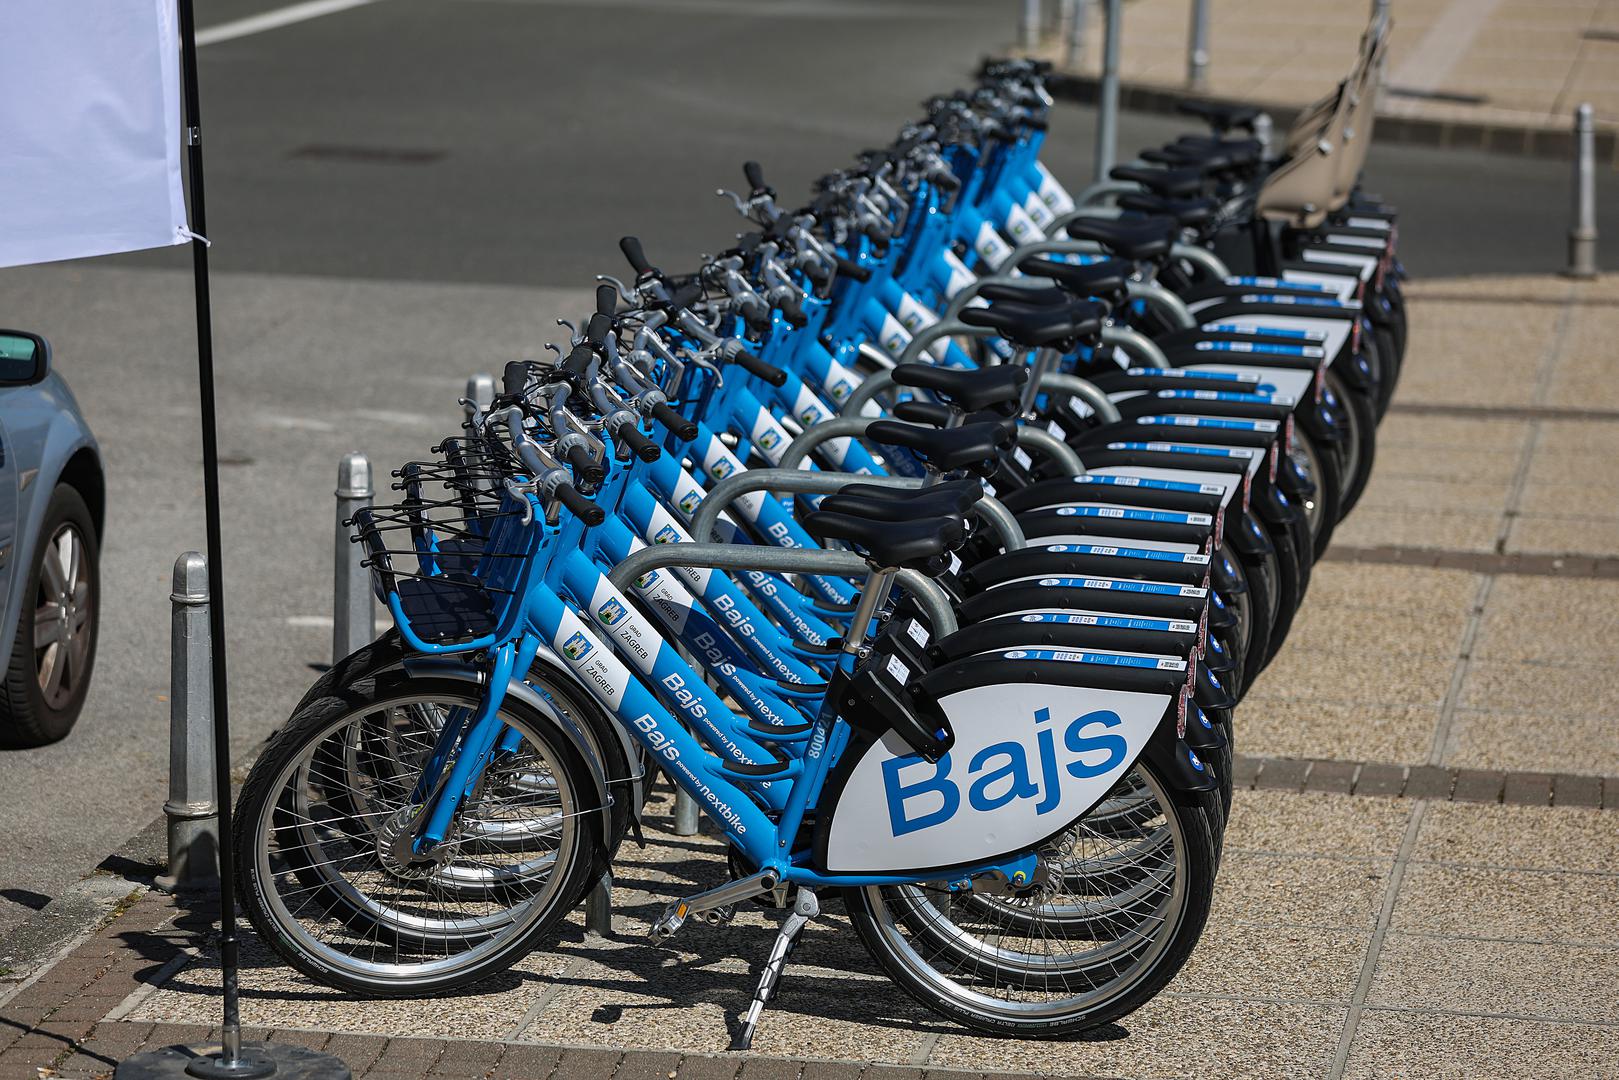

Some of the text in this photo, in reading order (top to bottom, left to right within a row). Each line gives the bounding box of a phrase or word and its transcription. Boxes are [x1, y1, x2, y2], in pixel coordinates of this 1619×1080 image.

[660, 588, 674, 601] GRAD
[747, 570, 777, 597] ajs
[652, 593, 680, 622] ZAGREB
[629, 624, 642, 638] GRAD
[713, 593, 755, 637] Bajs
[751, 636, 770, 655] powered
[768, 652, 775, 660] by
[620, 630, 649, 660] ZAGREB
[585, 665, 616, 696] ZAGREB
[594, 659, 608, 674] GRAD
[693, 631, 737, 676] Bajs
[732, 675, 751, 695] powered
[749, 692, 757, 701] by
[662, 672, 707, 718] Bajs
[703, 717, 723, 738] powered
[720, 735, 729, 744] by
[808, 712, 833, 759] 800421
[633, 713, 747, 834] Bajs powered by nextbike
[881, 705, 1128, 838] Bajs
[1049, 1014, 1087, 1027] SCHWALBE
